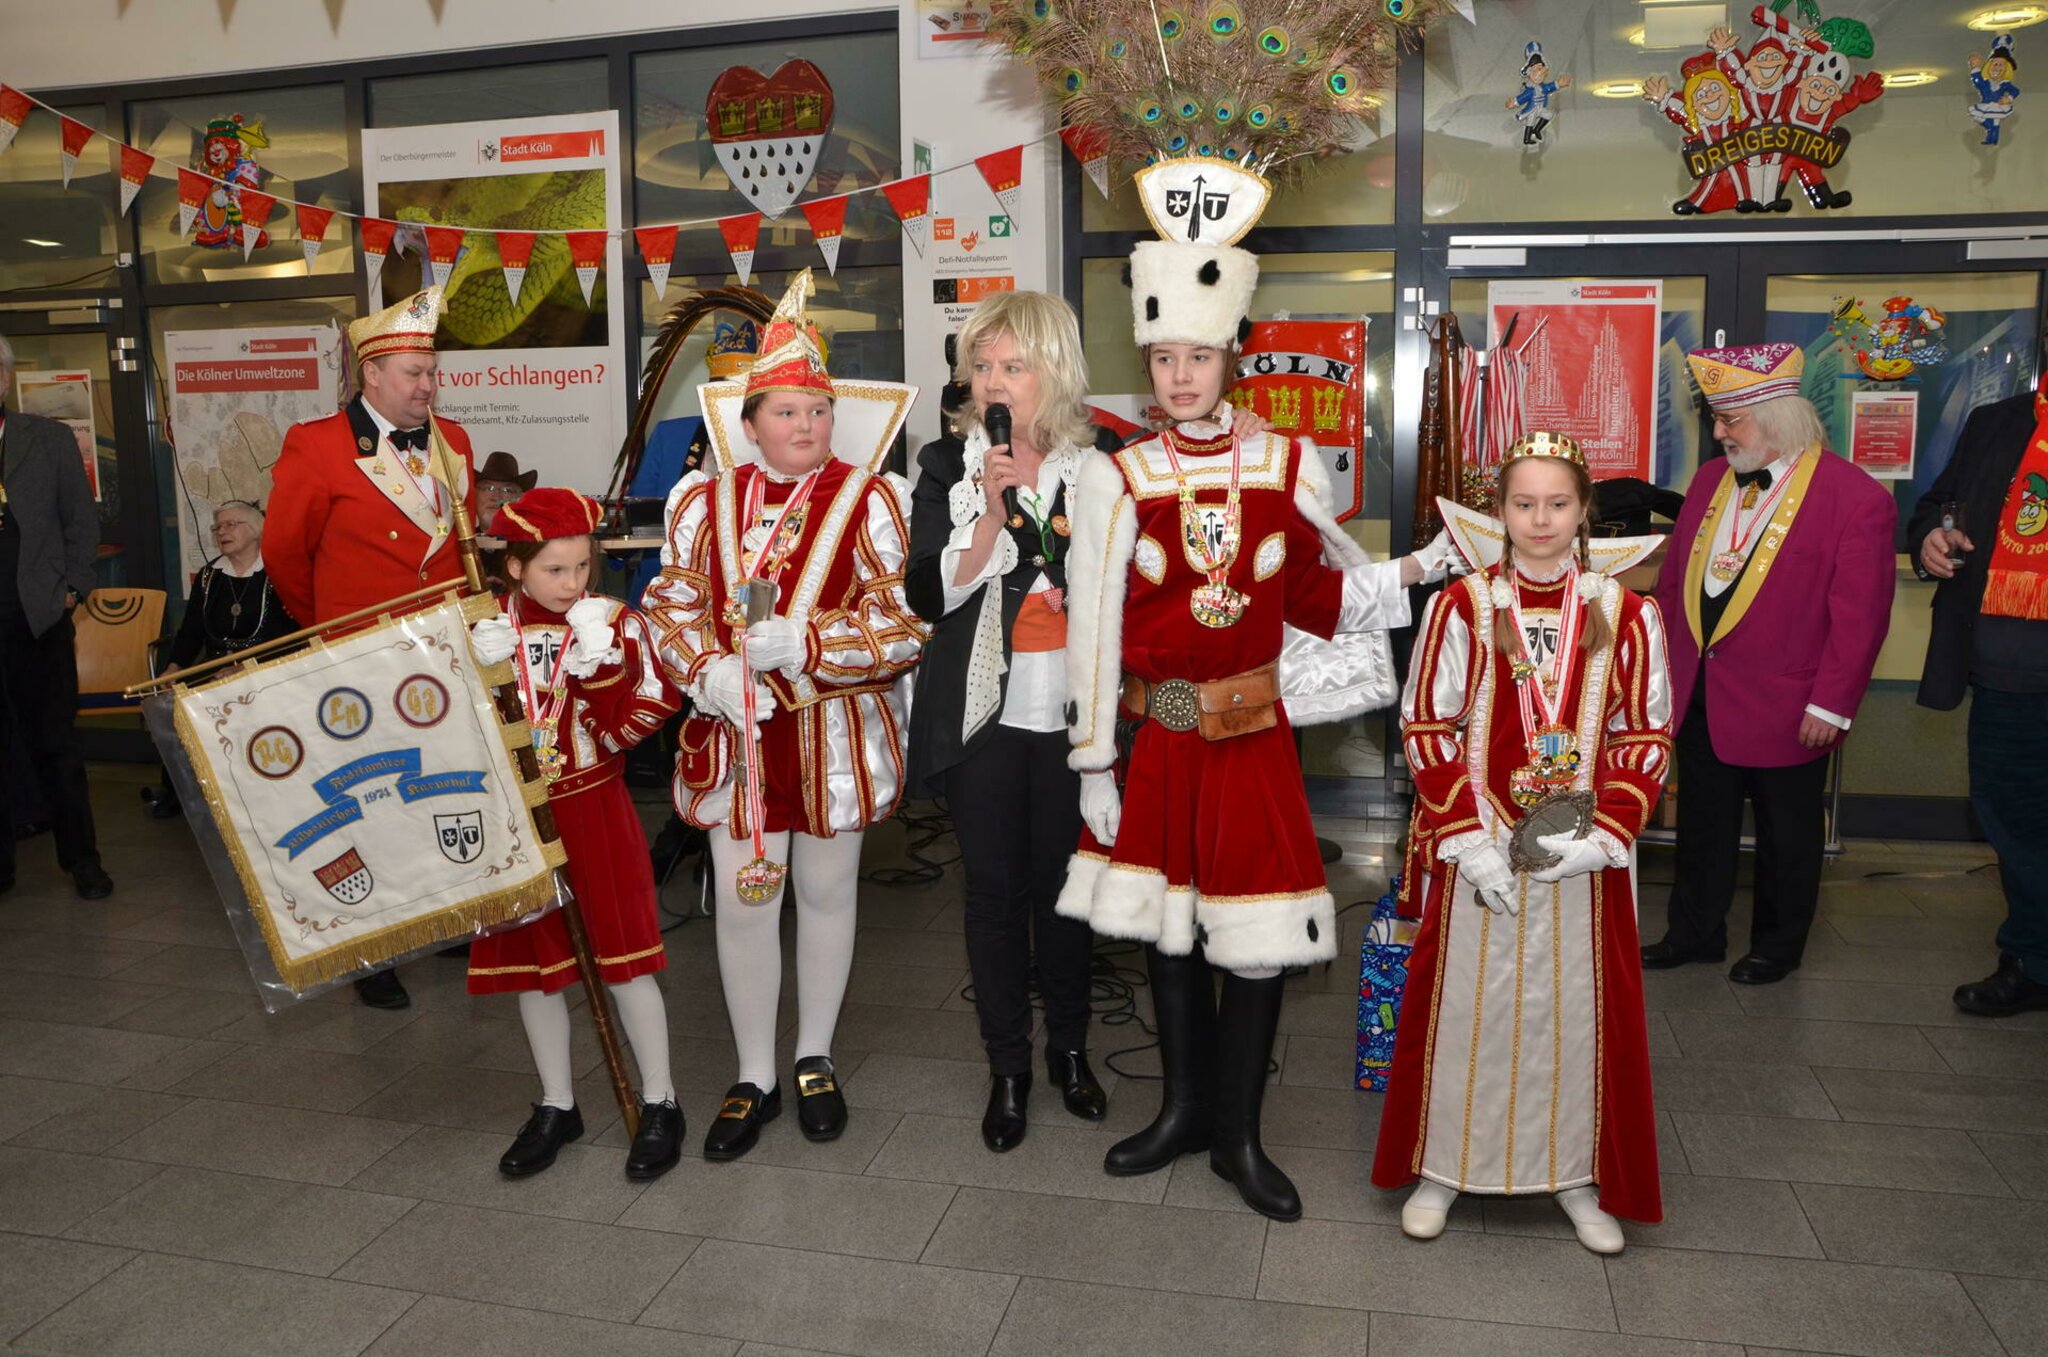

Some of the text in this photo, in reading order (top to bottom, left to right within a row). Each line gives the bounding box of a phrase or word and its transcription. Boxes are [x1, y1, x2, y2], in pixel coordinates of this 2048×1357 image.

[503, 142, 553, 156] Stadt Köln
[1691, 126, 1841, 176] DREIGESTIRN
[380, 150, 456, 162] Der Oberbürgermeister
[938, 255, 1008, 264] Defi-Notfallsystem
[1598, 288, 1611, 296] Köln
[176, 366, 305, 382] Die Kölner Umweltzone
[450, 370, 483, 387] vor
[488, 364, 605, 390] Schlangen?
[434, 402, 520, 415] eschlange mit Termin:
[506, 413, 590, 425] Kfz-Zulassungsstelle
[1581, 438, 1622, 449] Stellen
